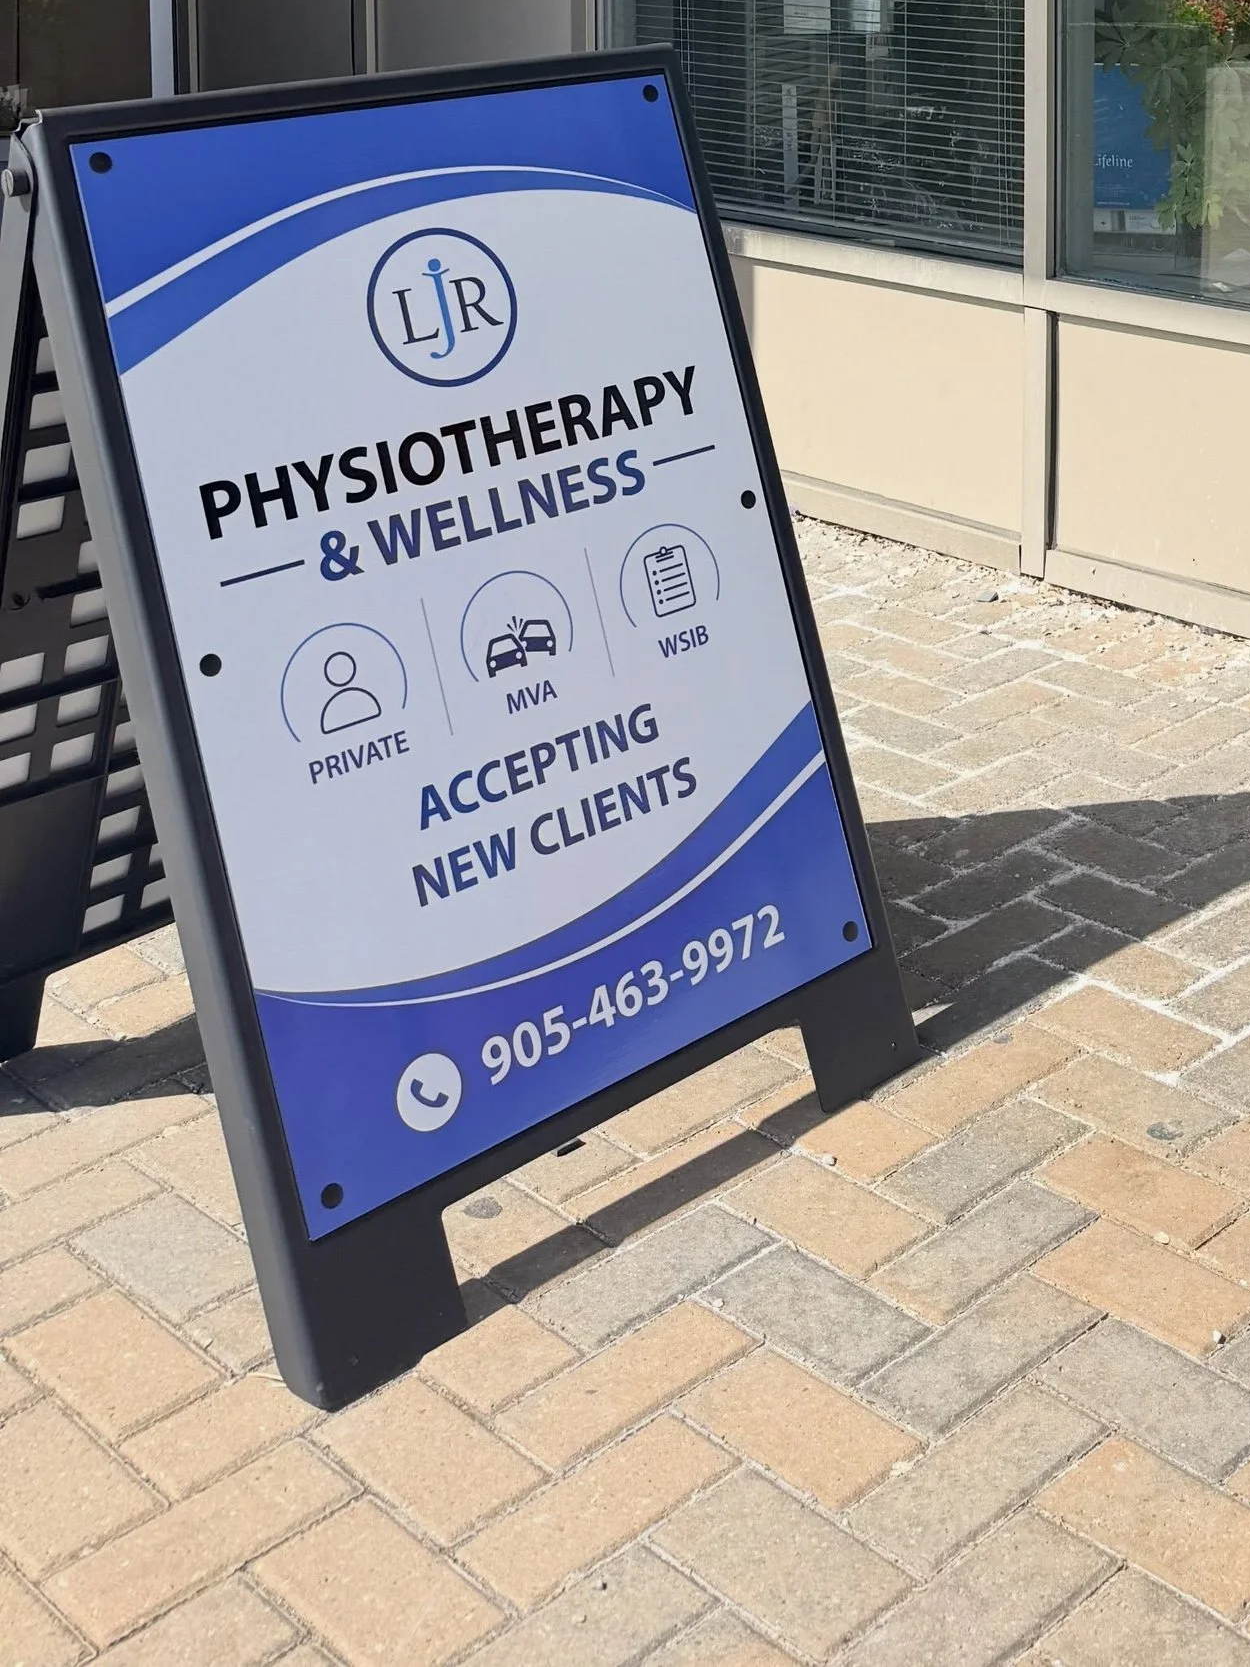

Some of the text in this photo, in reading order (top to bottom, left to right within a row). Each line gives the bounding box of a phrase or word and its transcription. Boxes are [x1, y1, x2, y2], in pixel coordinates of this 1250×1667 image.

[392, 257, 505, 360] LJR
[199, 366, 697, 540] PHYSIOTHERAPY
[319, 449, 646, 582] & WELLNESS
[505, 679, 559, 715] MVA
[658, 624, 711, 659] WSIB
[307, 730, 411, 785] PRIVATE
[418, 703, 661, 831] ACCEPTING
[410, 756, 699, 907] NEW CLIENTS
[481, 903, 786, 1088] 905-463-9972
